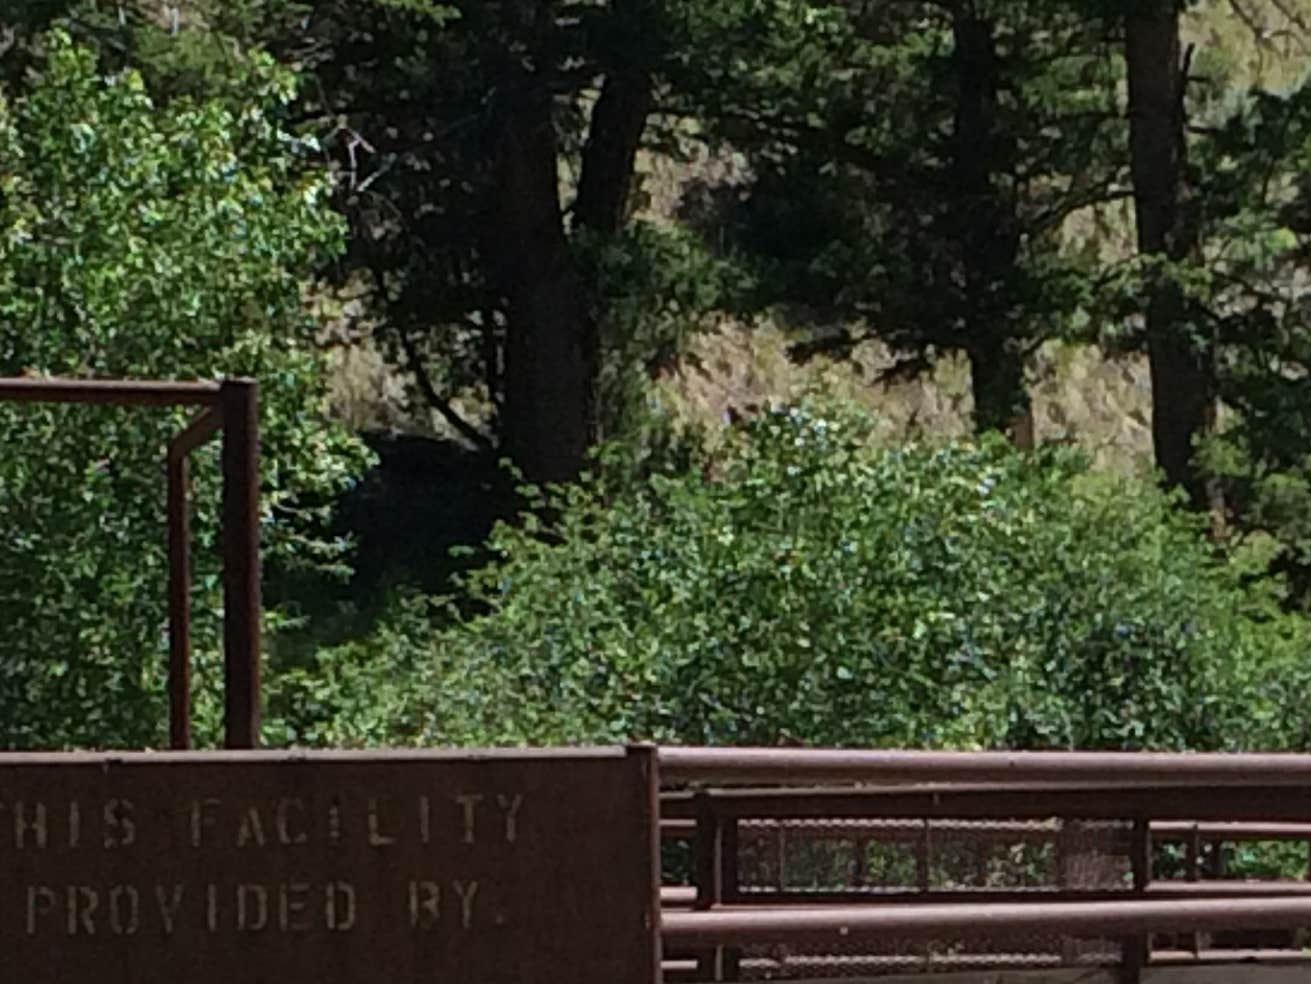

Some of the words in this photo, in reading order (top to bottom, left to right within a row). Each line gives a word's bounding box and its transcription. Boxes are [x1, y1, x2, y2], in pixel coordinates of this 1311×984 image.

[0, 799, 135, 849] HIS
[189, 794, 524, 848] FACILITY
[26, 880, 358, 934] PROVIDED
